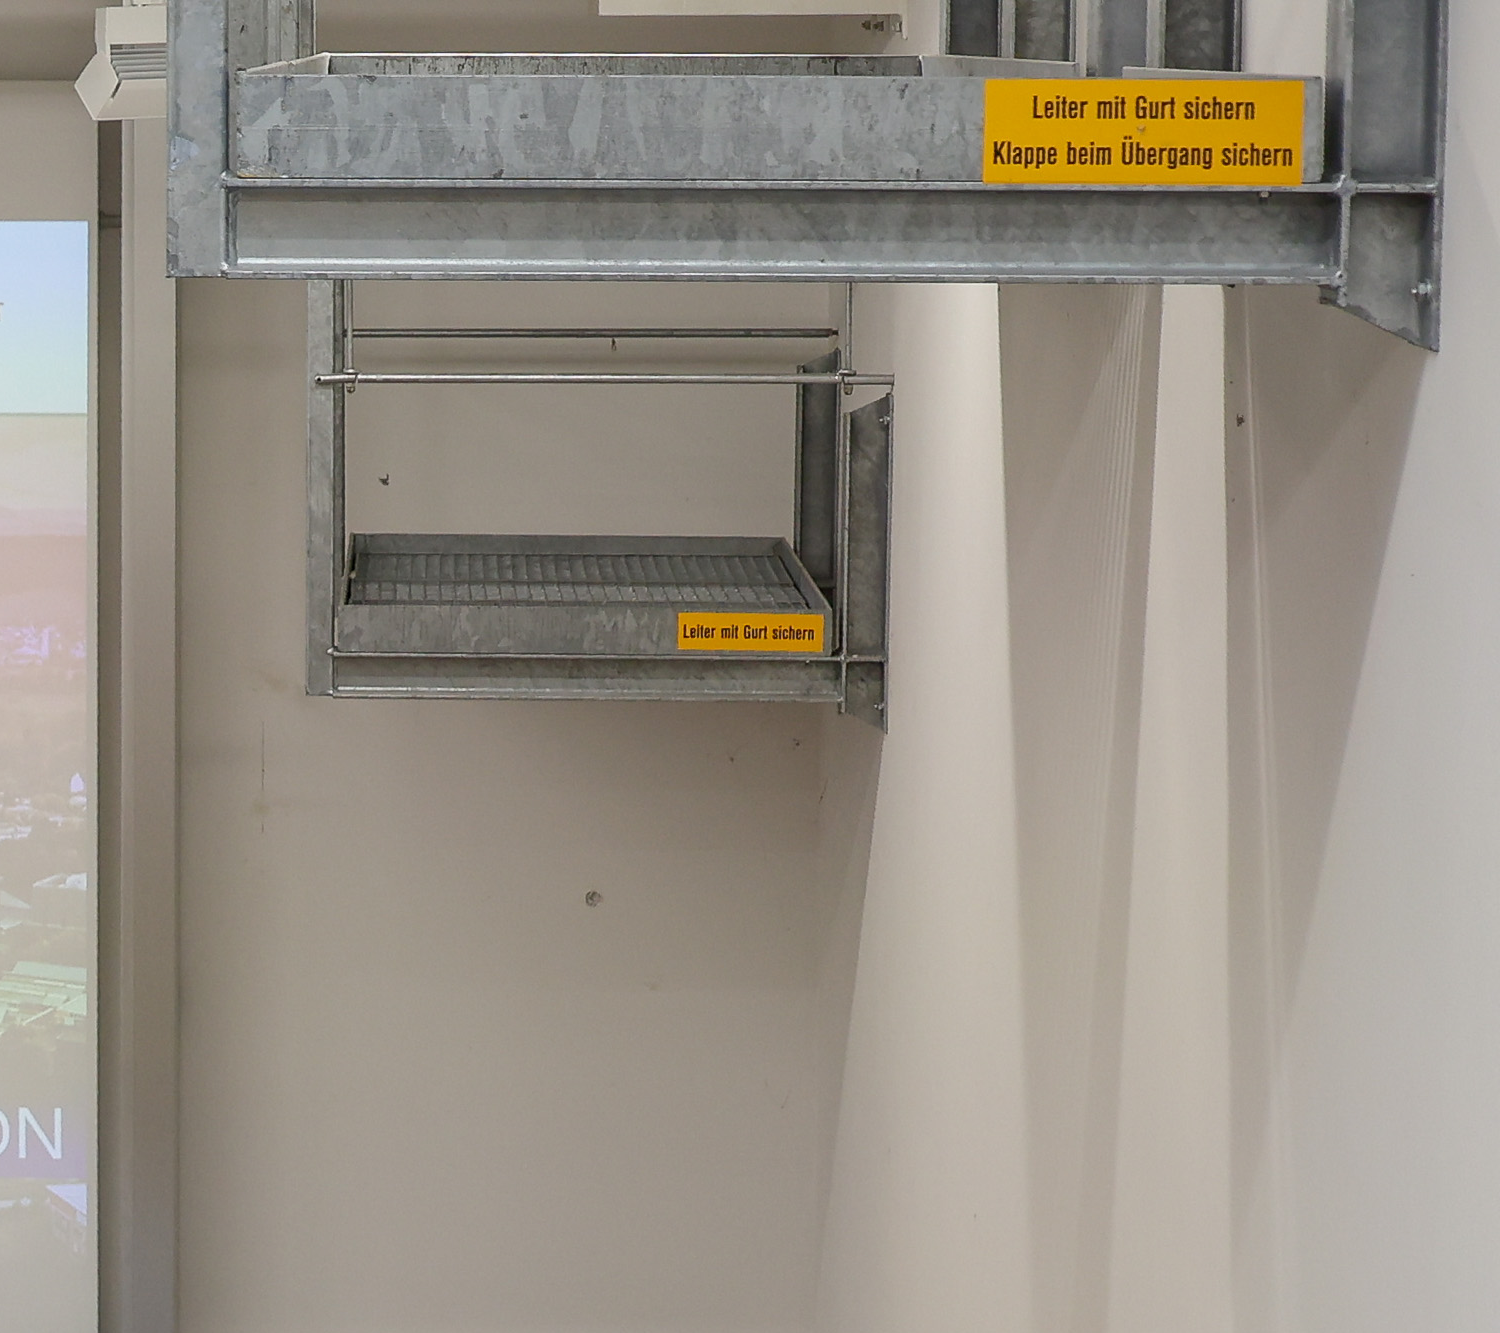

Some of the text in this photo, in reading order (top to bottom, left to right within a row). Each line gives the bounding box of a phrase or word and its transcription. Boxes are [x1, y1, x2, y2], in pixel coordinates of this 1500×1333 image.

[1032, 95, 1256, 121] Leiter mit Gurt sichern
[992, 136, 1293, 170] Klappe beim Übergang sichern
[683, 623, 815, 641] Leiter mit Gurt sichern
